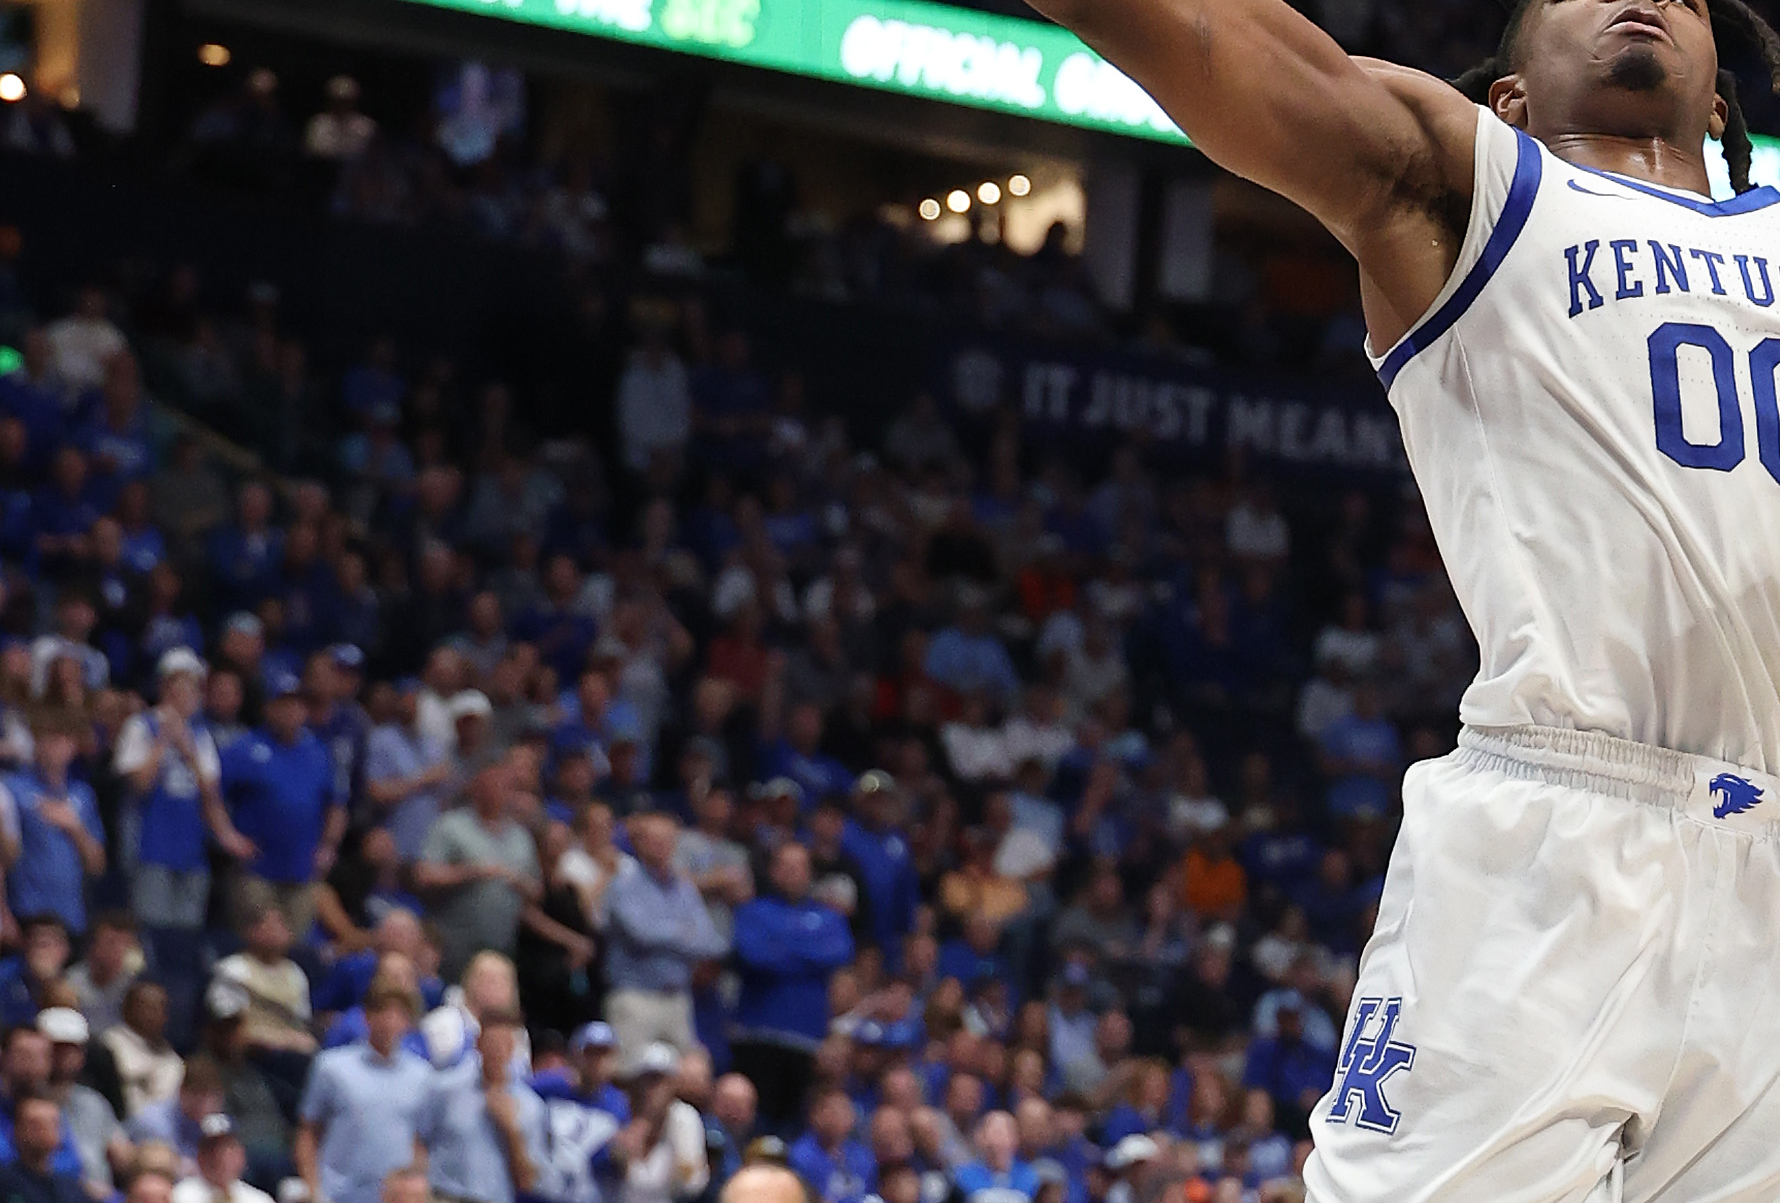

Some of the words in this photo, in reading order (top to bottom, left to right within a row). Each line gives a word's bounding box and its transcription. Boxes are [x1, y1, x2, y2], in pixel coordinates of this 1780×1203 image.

[841, 14, 1046, 108] OFFICIAL
[1023, 362, 1079, 420] IT
[1084, 373, 1212, 443] JUST
[1225, 395, 1397, 464] MEAN
